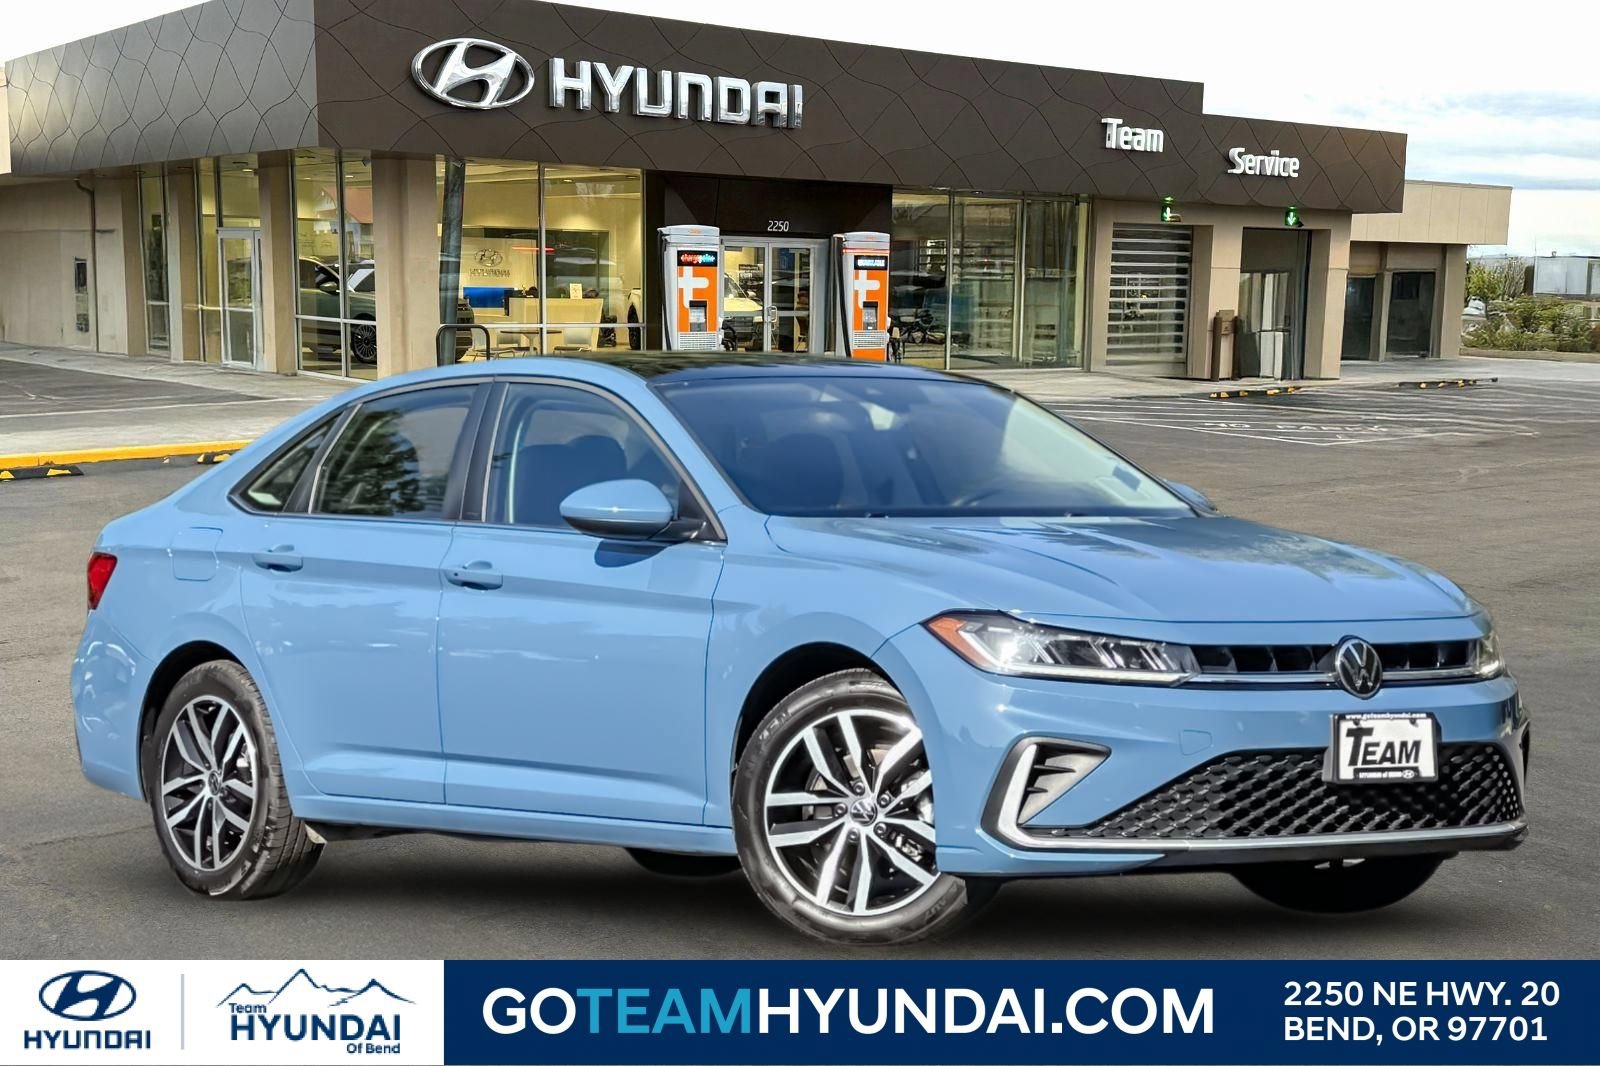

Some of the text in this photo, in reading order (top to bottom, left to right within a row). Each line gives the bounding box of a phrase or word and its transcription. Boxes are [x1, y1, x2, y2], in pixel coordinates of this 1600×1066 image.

[550, 57, 804, 129] HYUNDAI
[1101, 116, 1165, 153] Team
[1228, 146, 1301, 179] Service
[767, 220, 790, 232] 2250
[1345, 727, 1422, 766] TEAM
